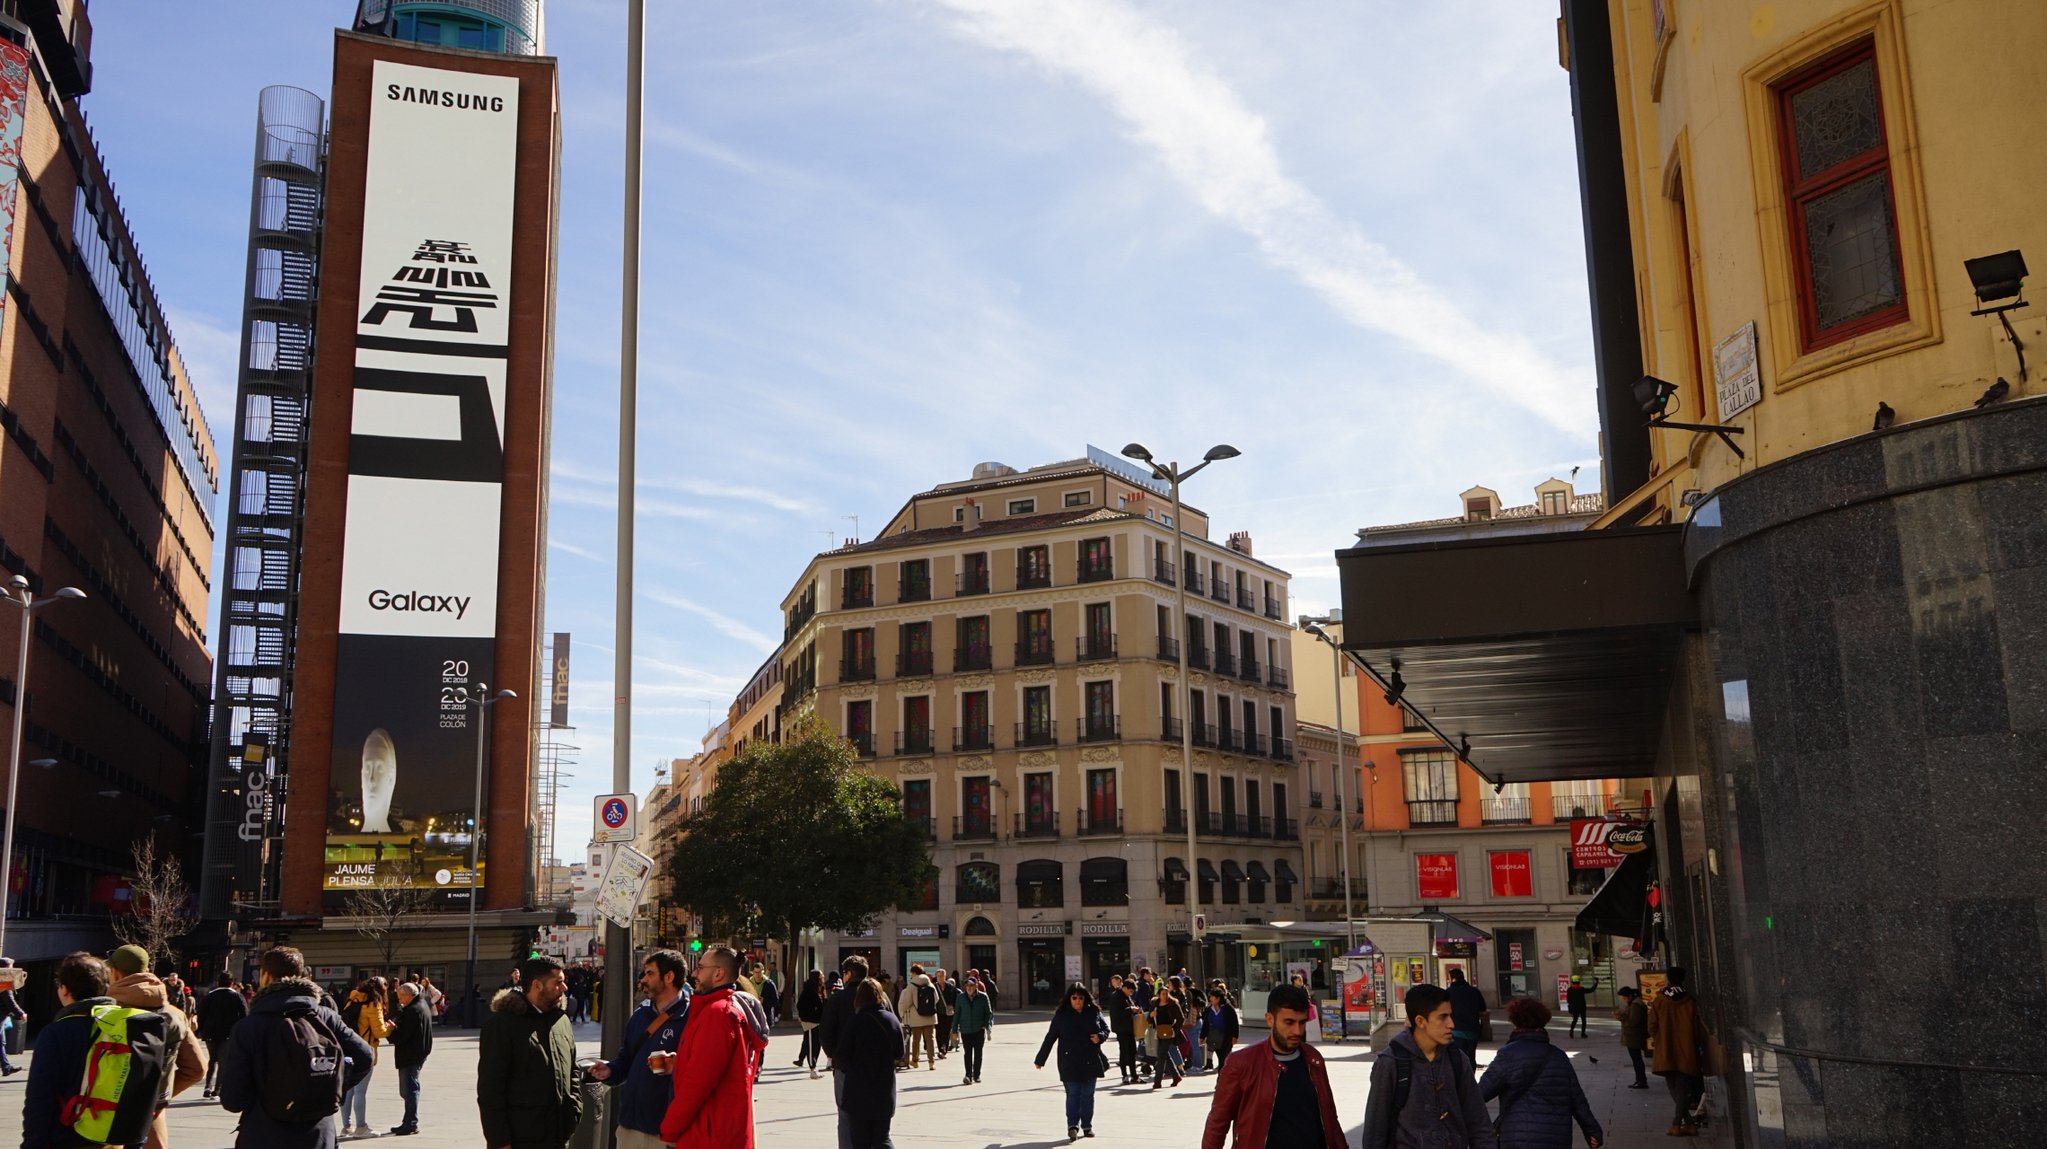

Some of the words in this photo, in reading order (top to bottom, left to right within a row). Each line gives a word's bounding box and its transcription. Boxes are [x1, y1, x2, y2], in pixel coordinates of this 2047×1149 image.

[387, 84, 504, 112] SAMSUNG
[1720, 382, 1741, 402] PLAZA
[1742, 374, 1756, 387] DEL
[1723, 386, 1755, 416] CALLAO
[368, 589, 471, 620] Galaxy
[442, 660, 469, 677] 20
[553, 657, 568, 705] fnac
[440, 720, 466, 728] COLÓN
[238, 771, 265, 842] fnac
[335, 864, 376, 874] JAUME
[328, 875, 374, 887] PLENSA
[1019, 926, 1063, 934] RODILLA
[1083, 924, 1128, 933] RODILLA
